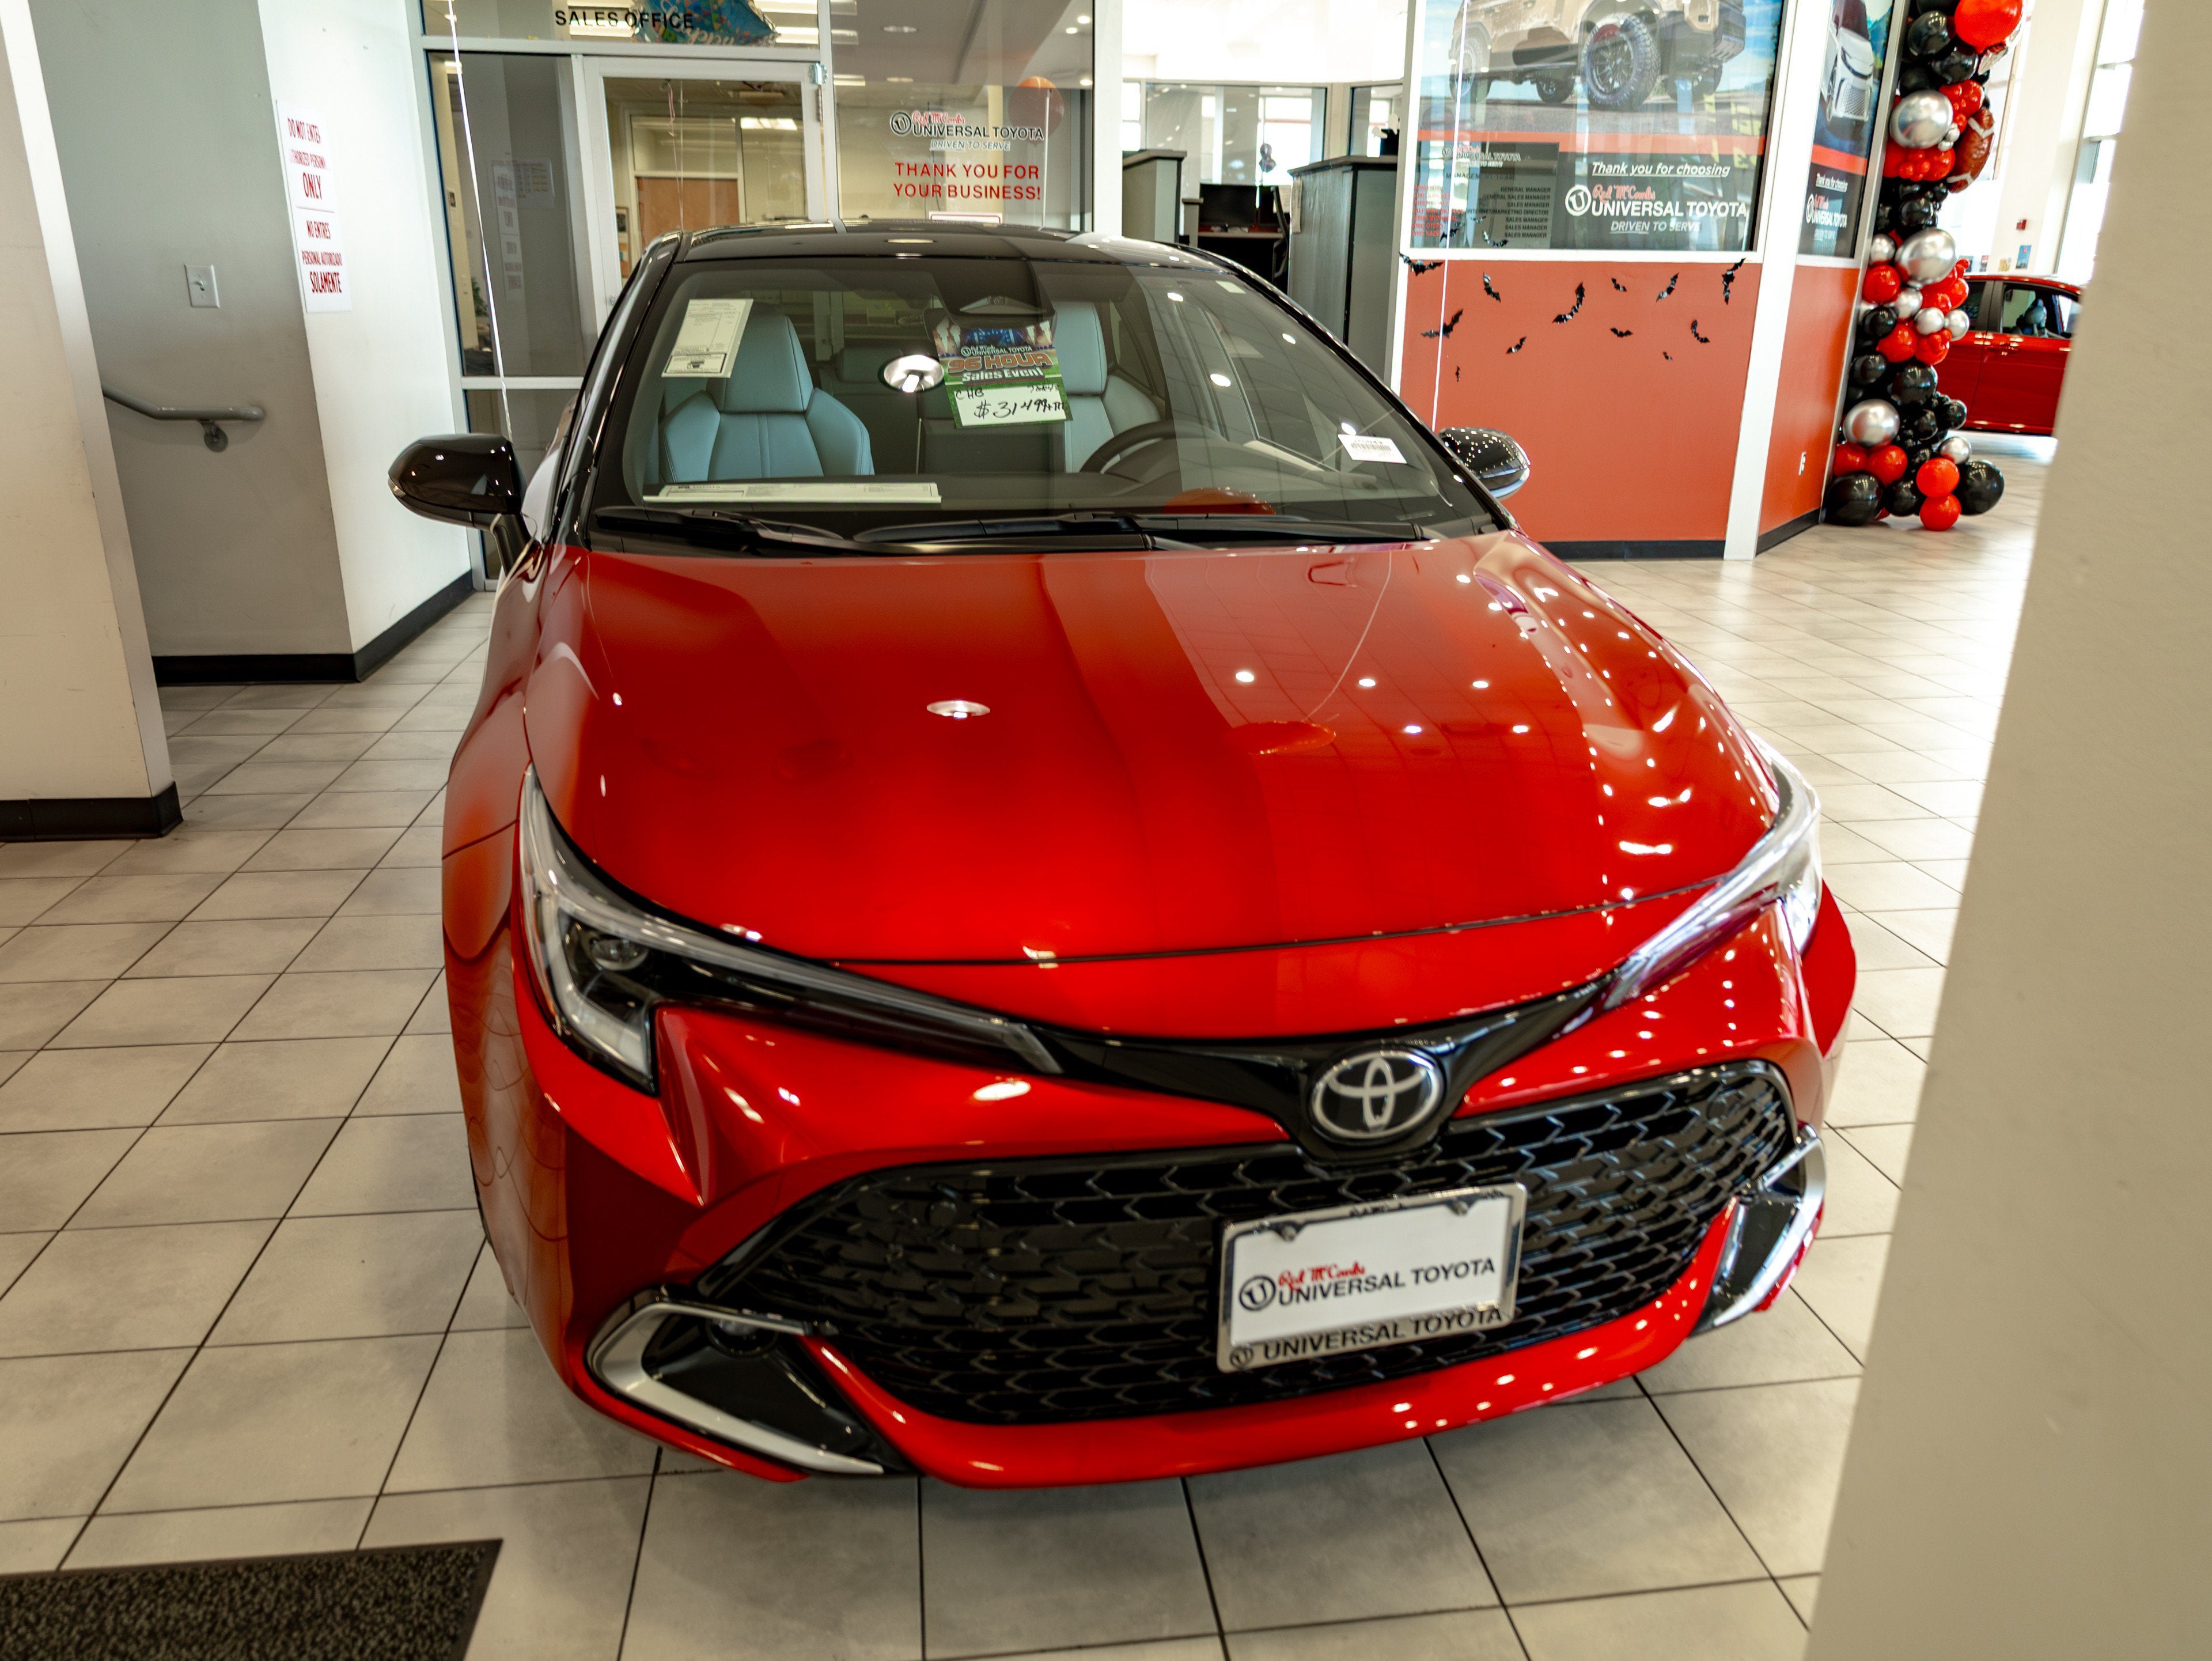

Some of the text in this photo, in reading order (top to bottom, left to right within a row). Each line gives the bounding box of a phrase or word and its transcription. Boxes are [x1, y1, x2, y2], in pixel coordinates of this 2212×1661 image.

[555, 10, 694, 29] SALES OFFICE
[287, 117, 296, 138] DO
[296, 120, 306, 140] NOT
[912, 123, 990, 139] UNIVERSAL
[994, 126, 1044, 141] TOYOTA
[930, 139, 1010, 152] DRIVEN TO SERVE
[290, 149, 310, 166] THORIZED
[1456, 152, 1493, 161] NIVERSAL
[895, 162, 1039, 179] THANK YOU FOR
[1592, 162, 1730, 177] Thank you for choosing
[302, 172, 322, 200] ONLY
[893, 184, 1041, 200] YOUR BUSINESS!
[1592, 184, 1612, 202] Red
[1591, 200, 1683, 217] UNIVERSAL
[1687, 202, 1747, 217] TOYOTA
[306, 220, 331, 239] NO ENTRES
[1611, 221, 1702, 232] DRIVEN TO SERVE
[310, 271, 342, 293] SOLAMENTE
[972, 347, 1008, 356] UNIVERSAL
[948, 352, 1054, 373] 96 HOUR
[962, 367, 1044, 381] Sales Event
[1278, 1274, 1406, 1306] UNIVERSAL
[1411, 1258, 1496, 1285] TOYOTA
[1279, 1267, 1304, 1291] Red
[1263, 1321, 1407, 1361] UNIVERSAL
[1411, 1306, 1503, 1335] TOYOTA
